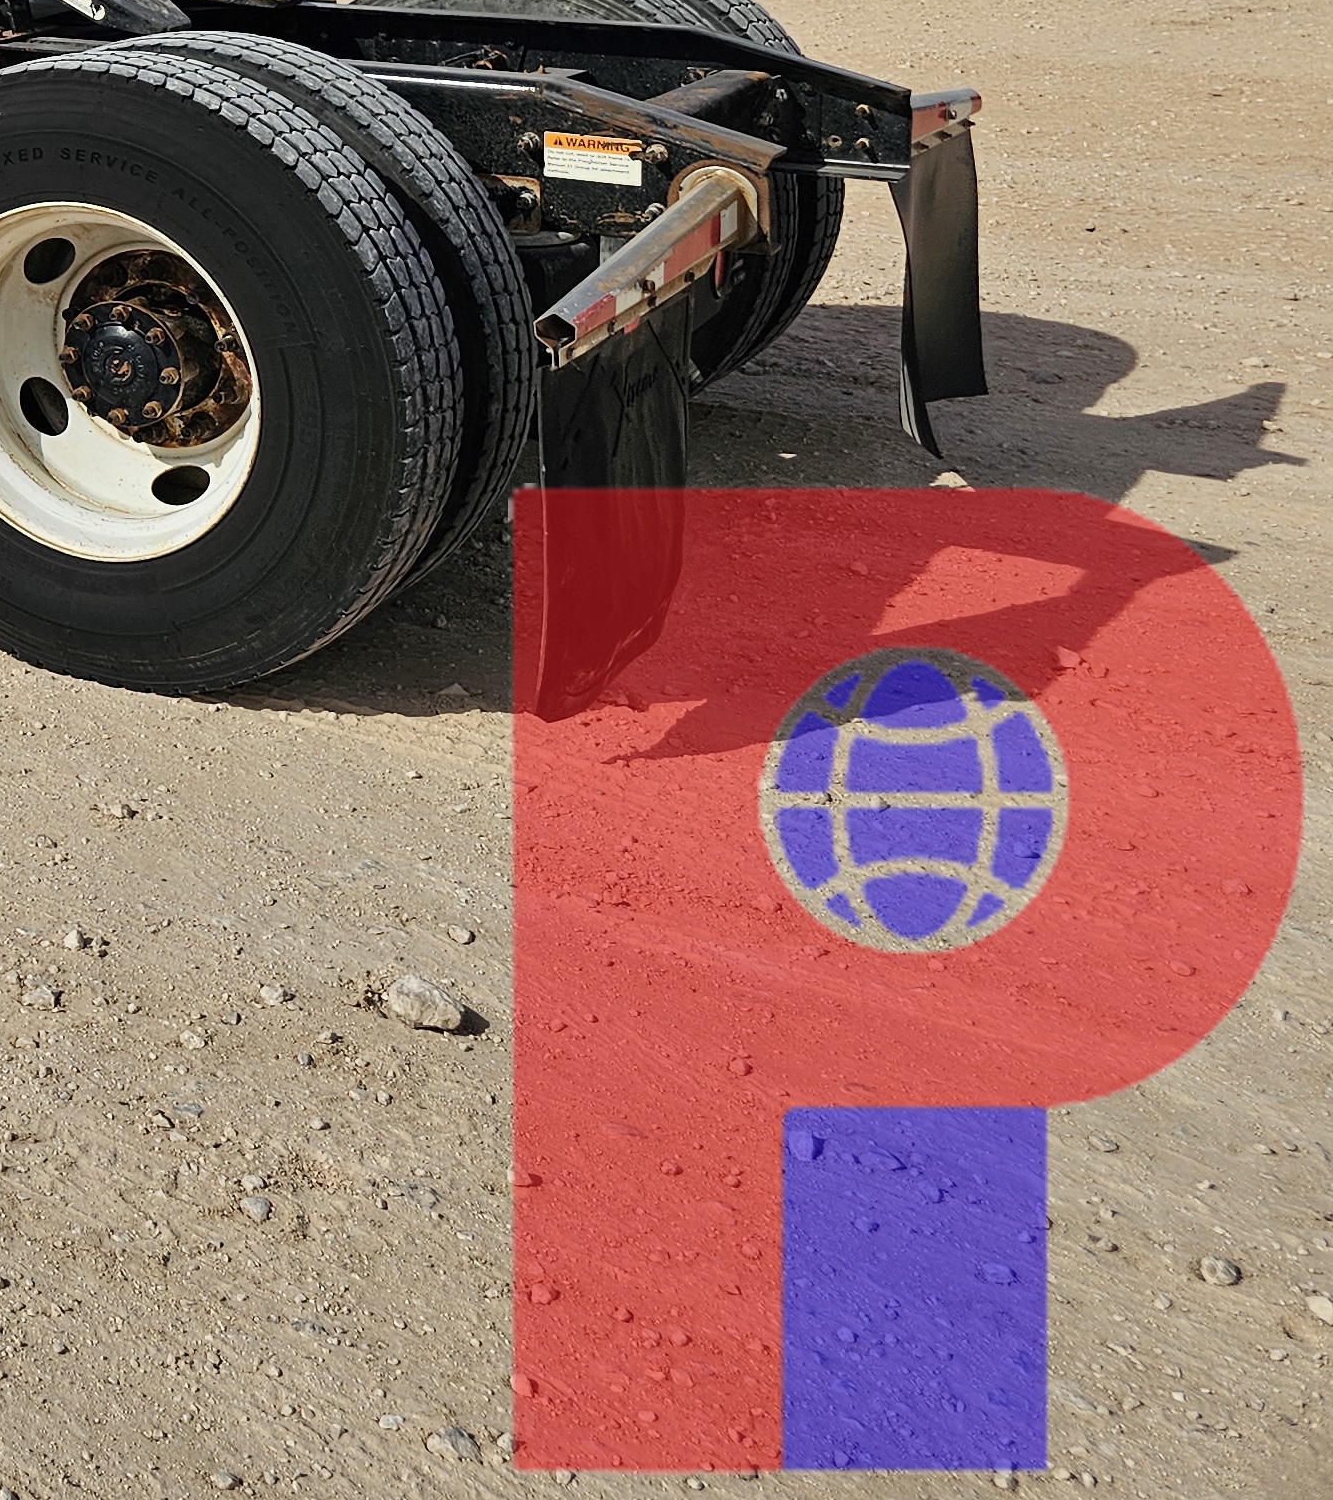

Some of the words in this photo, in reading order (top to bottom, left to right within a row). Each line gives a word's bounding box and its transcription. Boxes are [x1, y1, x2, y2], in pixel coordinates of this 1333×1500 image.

[565, 136, 630, 153] WARNING
[59, 146, 159, 185] SERVICE
[172, 186, 298, 333] ALL-POSITION
